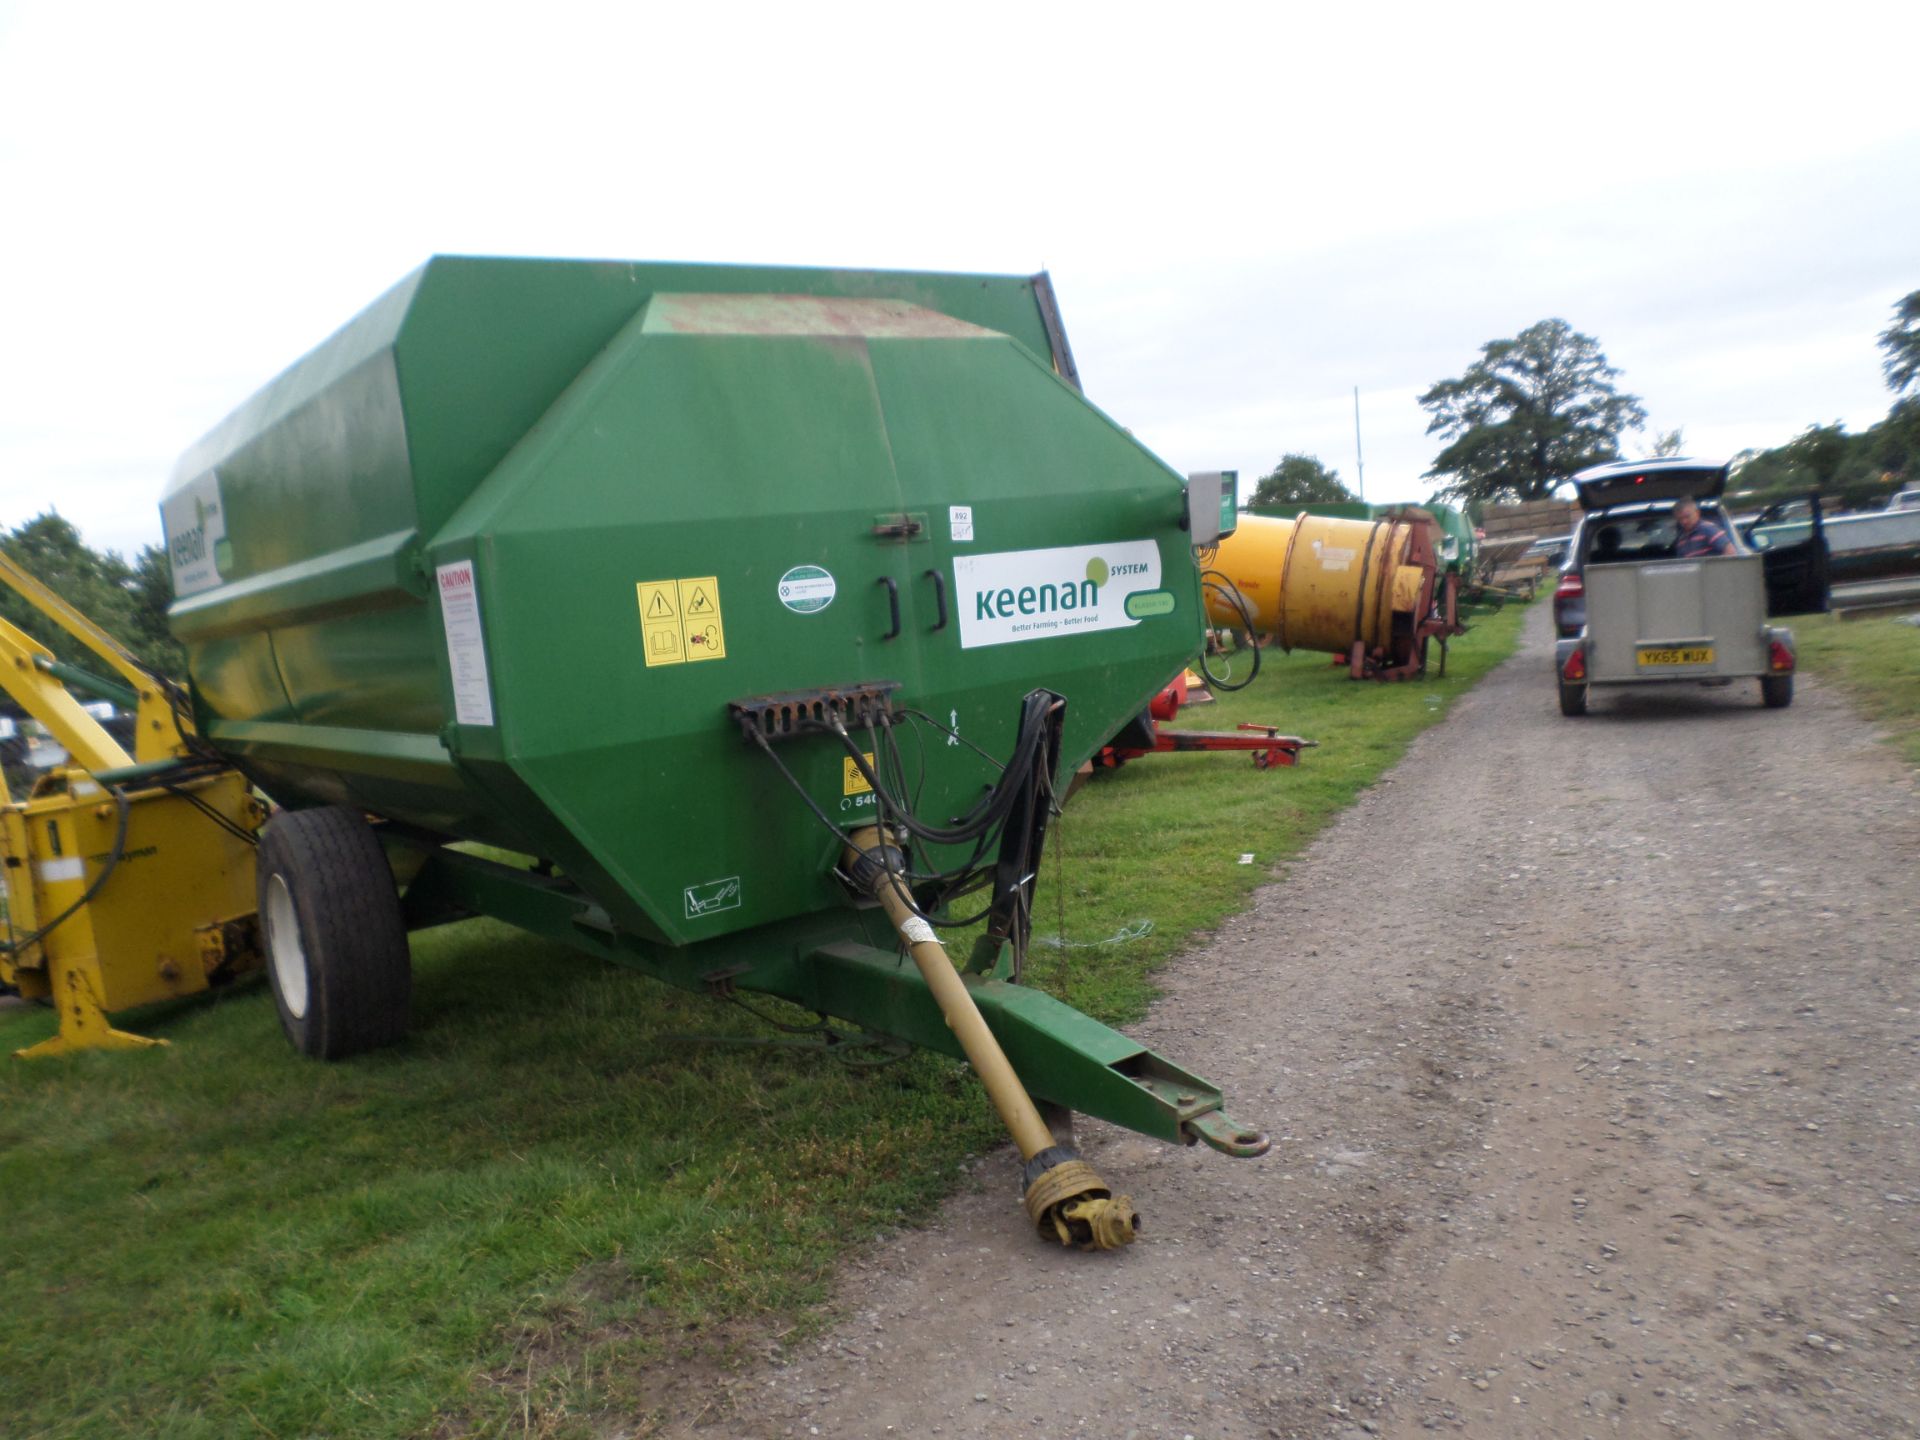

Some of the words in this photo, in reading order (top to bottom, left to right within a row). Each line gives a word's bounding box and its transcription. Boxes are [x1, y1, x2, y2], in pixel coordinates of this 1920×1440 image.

[440, 567, 471, 589] CAUTION
[1110, 562, 1149, 576] SYSTEM
[1011, 623, 1032, 633] Better
[1032, 619, 1058, 630] Farming
[1063, 616, 1083, 626] Better
[1084, 614, 1099, 624] Food
